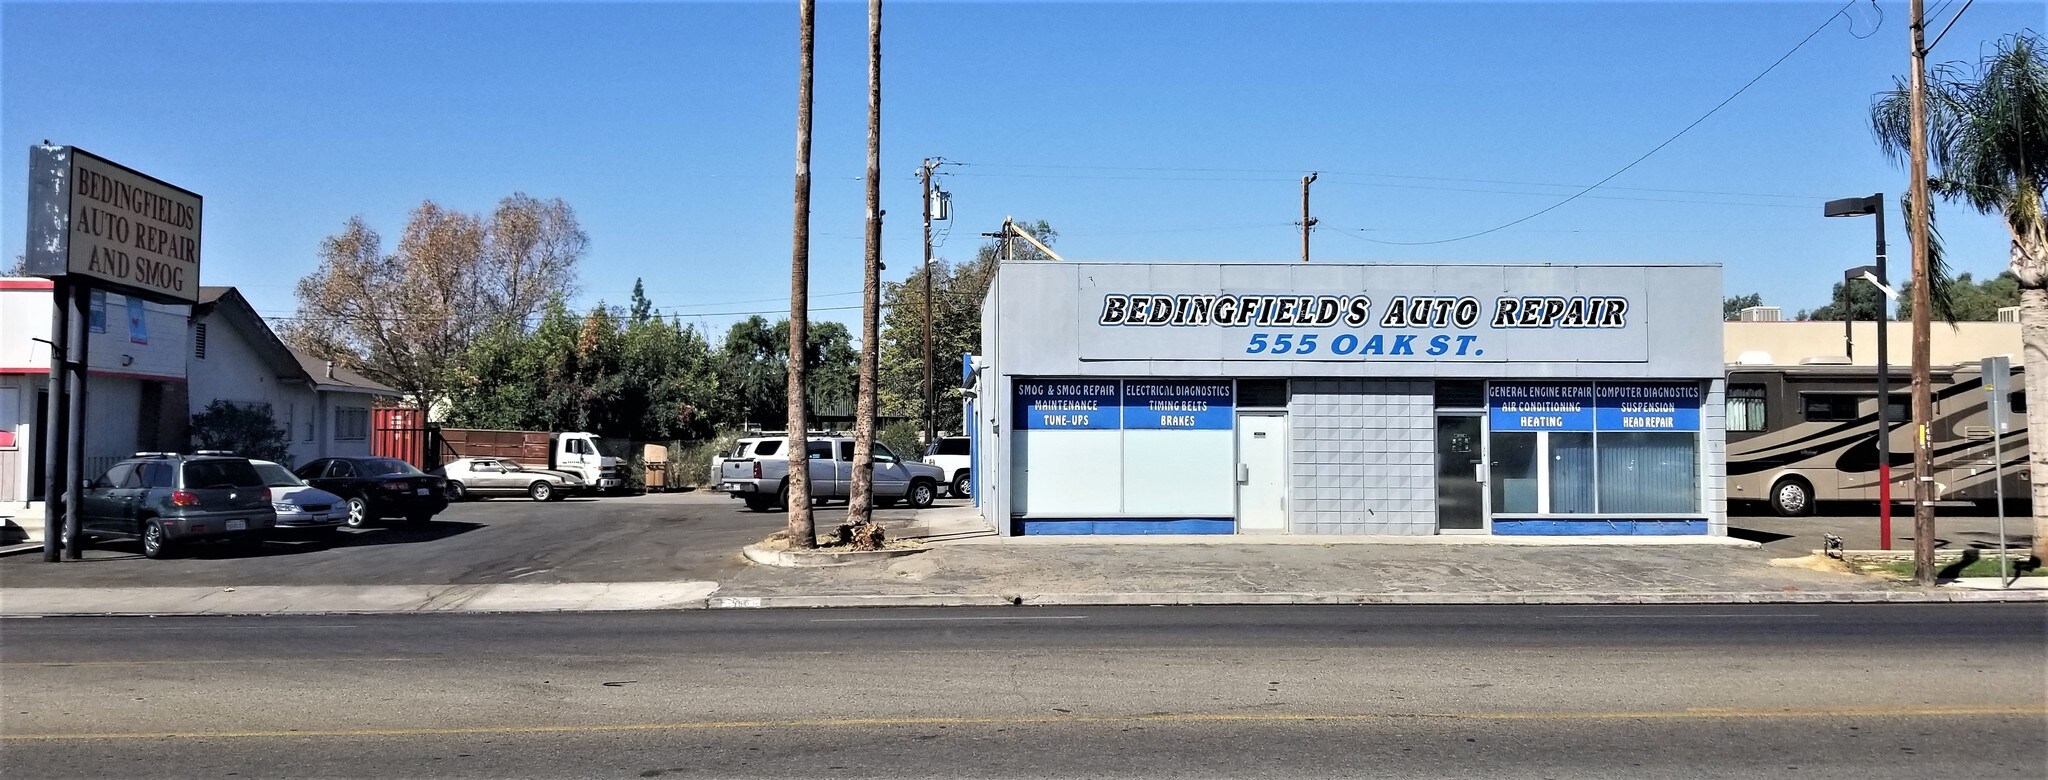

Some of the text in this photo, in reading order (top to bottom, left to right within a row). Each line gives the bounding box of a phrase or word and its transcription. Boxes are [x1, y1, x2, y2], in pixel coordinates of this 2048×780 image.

[78, 167, 194, 230] BEDINGFIELDS
[77, 206, 195, 263] AUTO REPAIR
[88, 245, 183, 291] AND SMOG
[1099, 294, 1628, 329] BEDINGFIELD'S AUTO REPAIR
[1245, 333, 1484, 356] 555 OAK ST.
[1018, 384, 1115, 396] SMOG & SMOG REPAIR
[1126, 384, 1230, 397] ELECTRICAL DIAGNOSTICS
[1489, 386, 1592, 398] GENERAL ENGINE REPAIR
[1596, 387, 1699, 398] COMPUTER DIAGNOSTICS
[1034, 400, 1098, 411] MAINTENANCE
[1149, 400, 1207, 412] TIMING BELTS
[1502, 401, 1581, 412] AIR CONDITIONING
[1621, 402, 1675, 413] SUSPENSION
[1043, 414, 1089, 426] TUNE-UPS
[1160, 415, 1195, 426] BRAKES
[1520, 416, 1563, 427] HEATING
[1623, 416, 1674, 428] HEAD REPAIR
